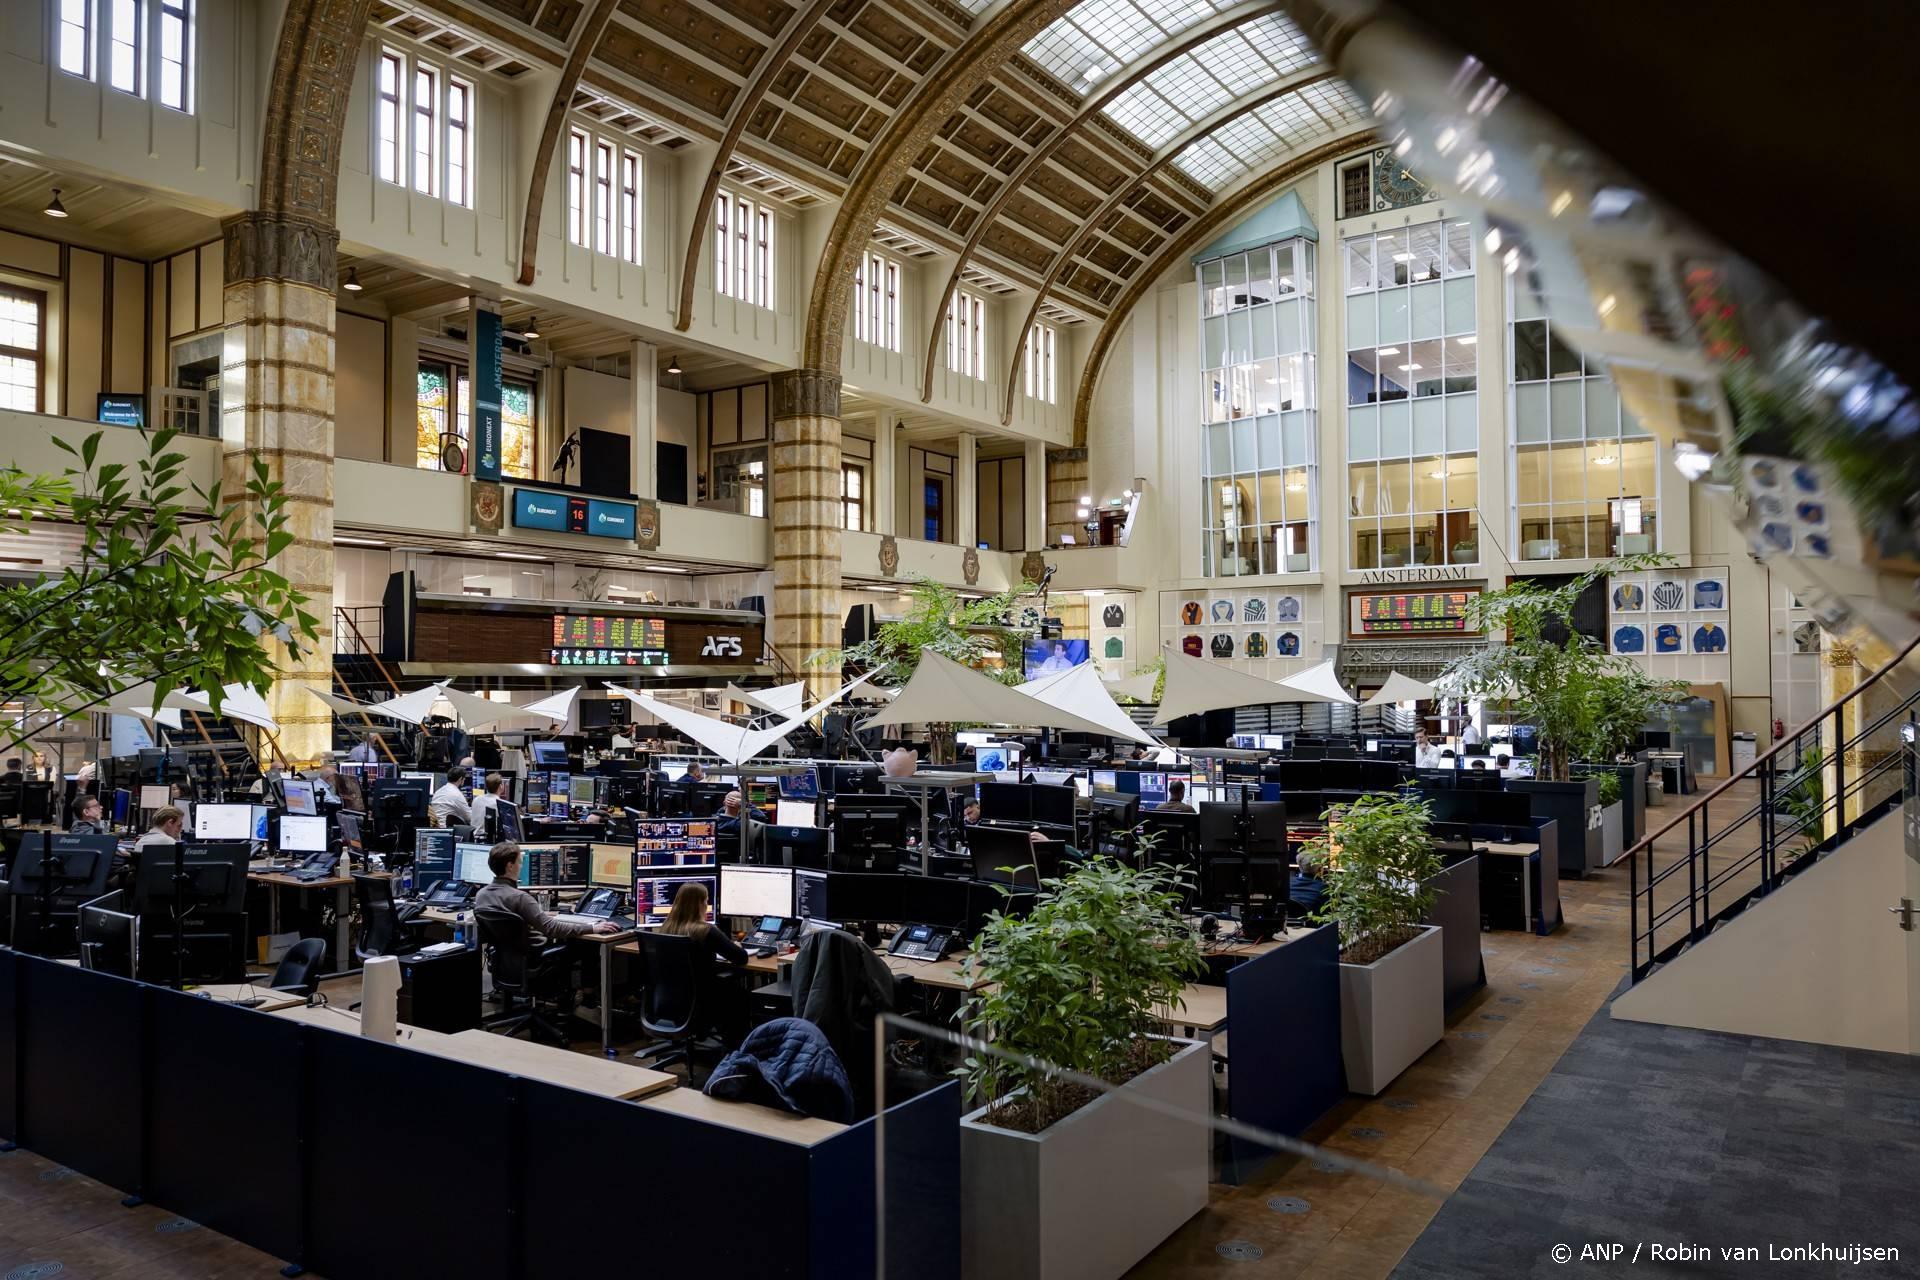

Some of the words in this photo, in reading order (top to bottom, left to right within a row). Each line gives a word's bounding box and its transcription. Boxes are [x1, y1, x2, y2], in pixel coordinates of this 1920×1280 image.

[485, 416, 493, 452] EURONEXT
[572, 509, 584, 520] 16
[1360, 566, 1467, 584] AMSTERDAM
[701, 635, 743, 657] AFS
